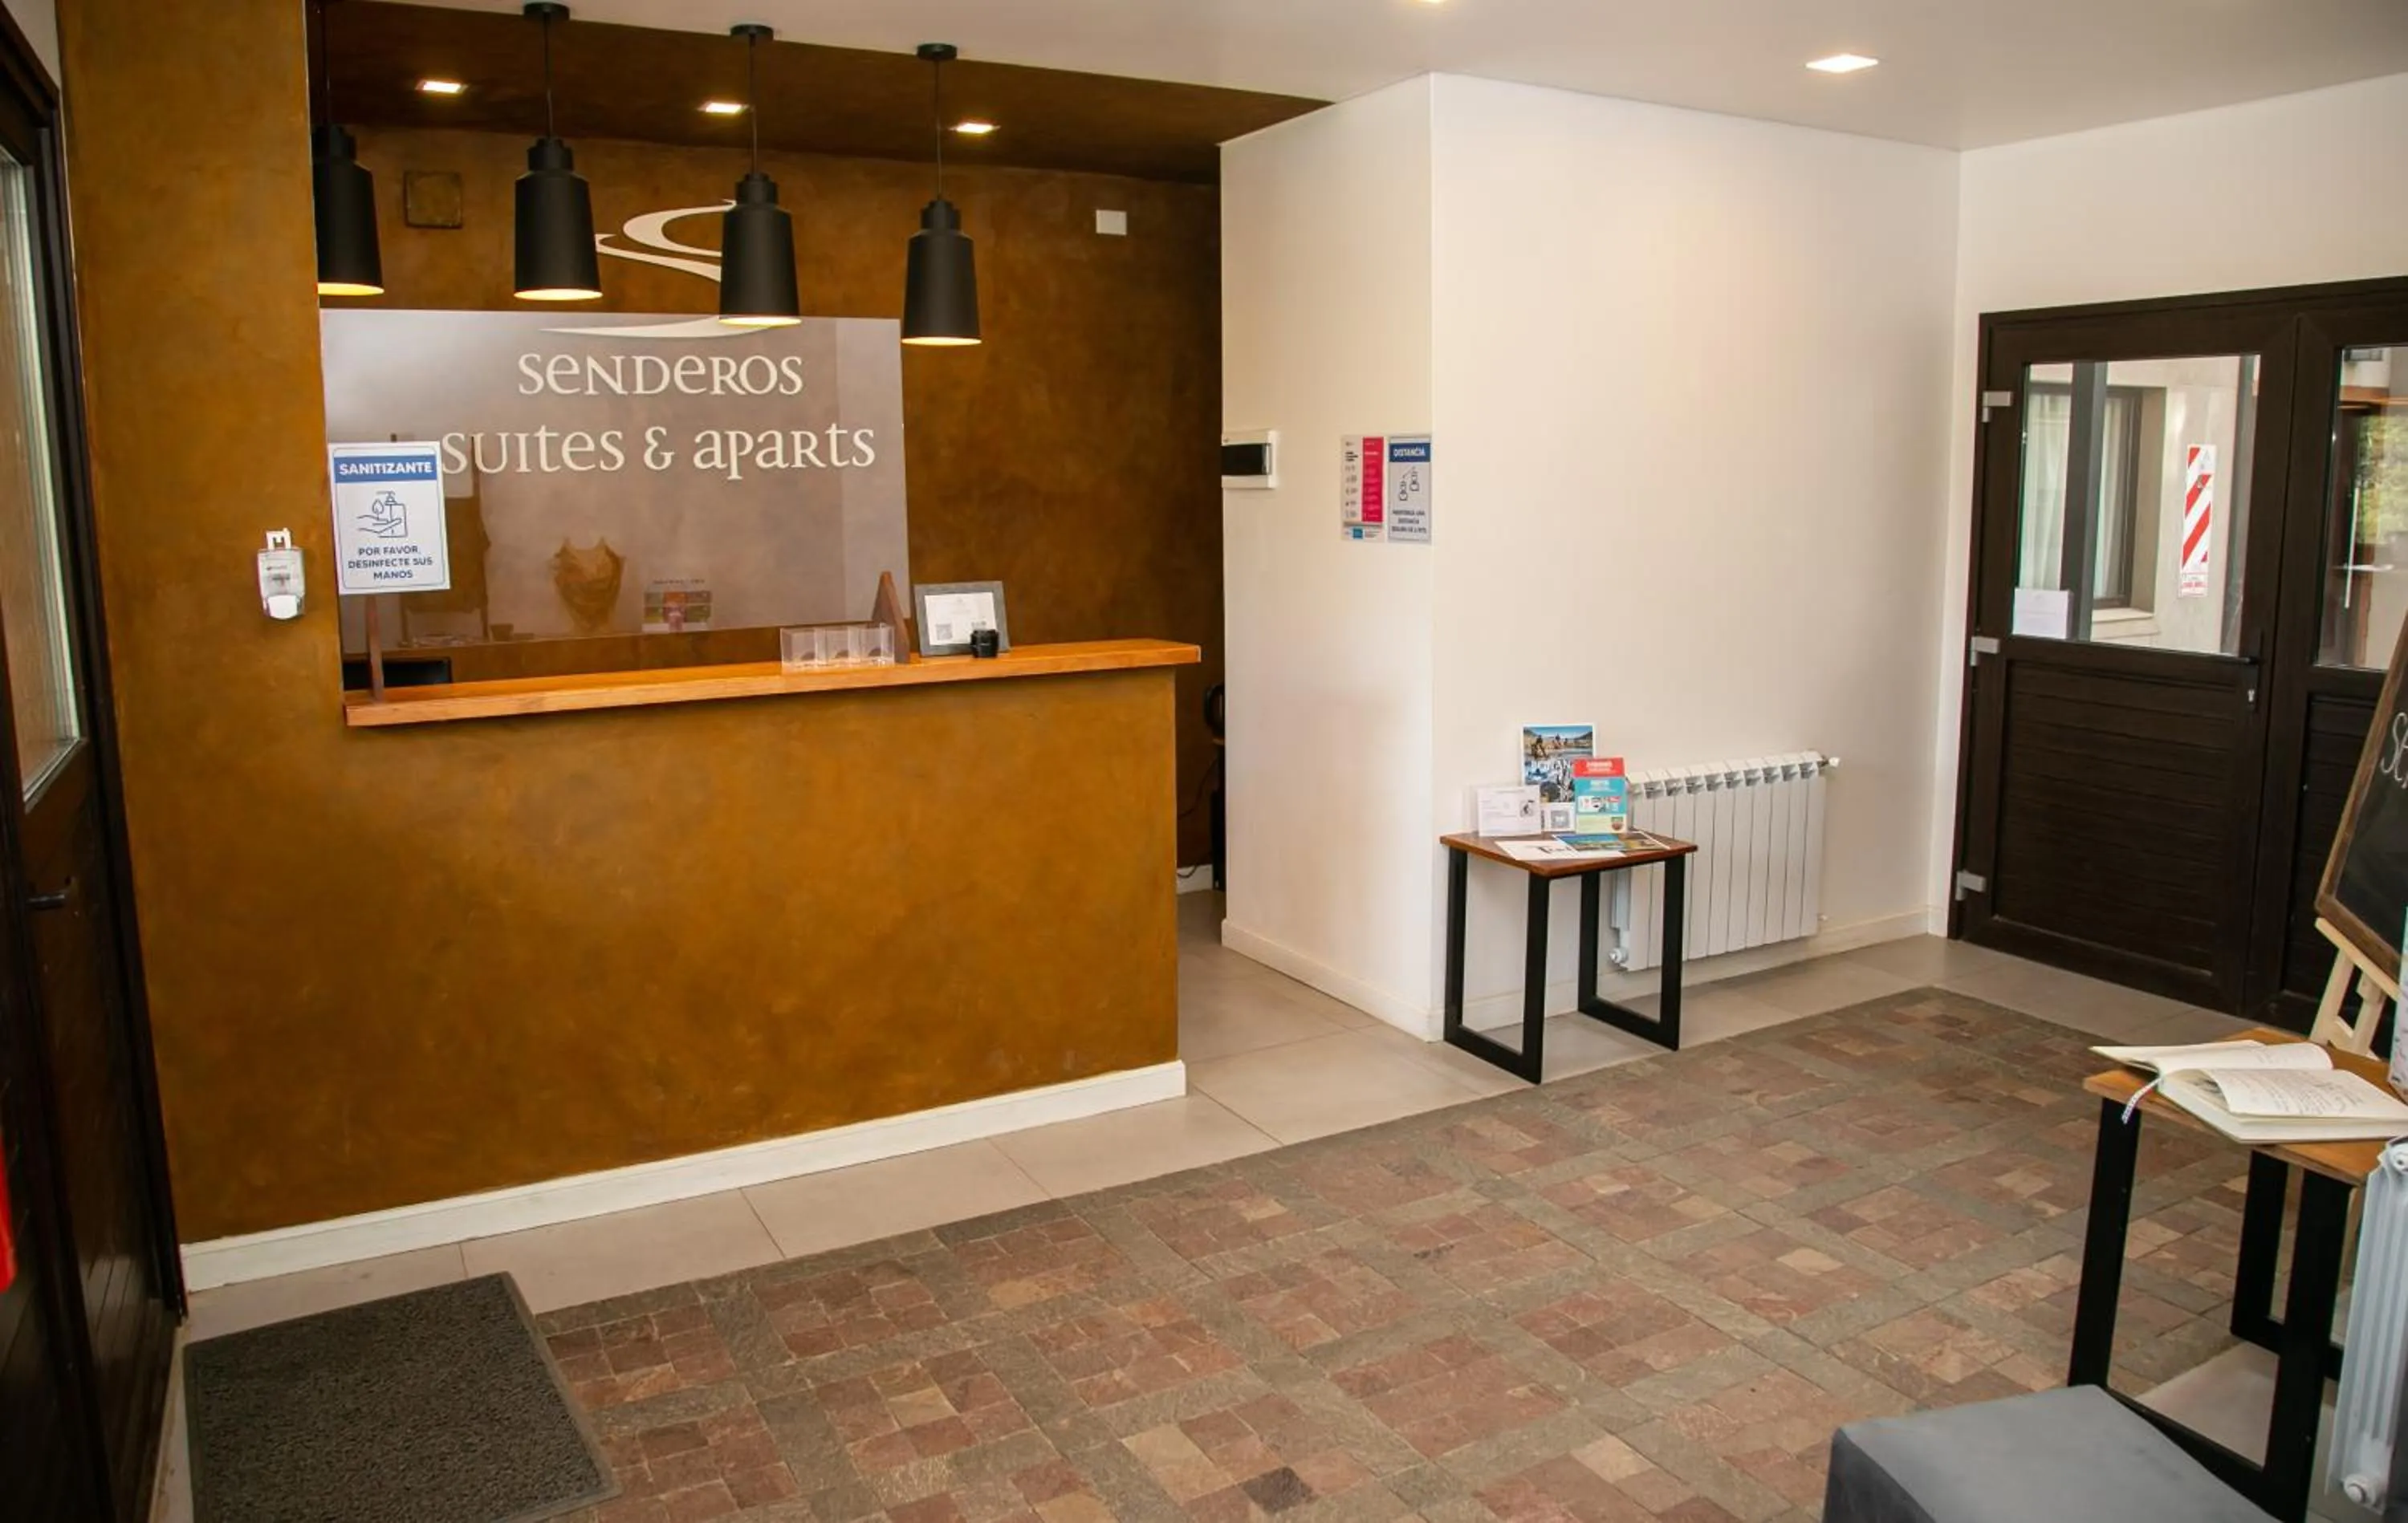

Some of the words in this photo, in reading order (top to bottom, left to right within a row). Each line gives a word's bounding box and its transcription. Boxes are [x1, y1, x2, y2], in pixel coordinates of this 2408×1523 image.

[645, 426, 674, 471] &
[339, 461, 433, 475] SANITIZANTE
[358, 547, 380, 556] POR
[348, 558, 409, 569] DESINFECTE
[413, 557, 433, 566] SUS
[373, 570, 413, 580] MANOS
